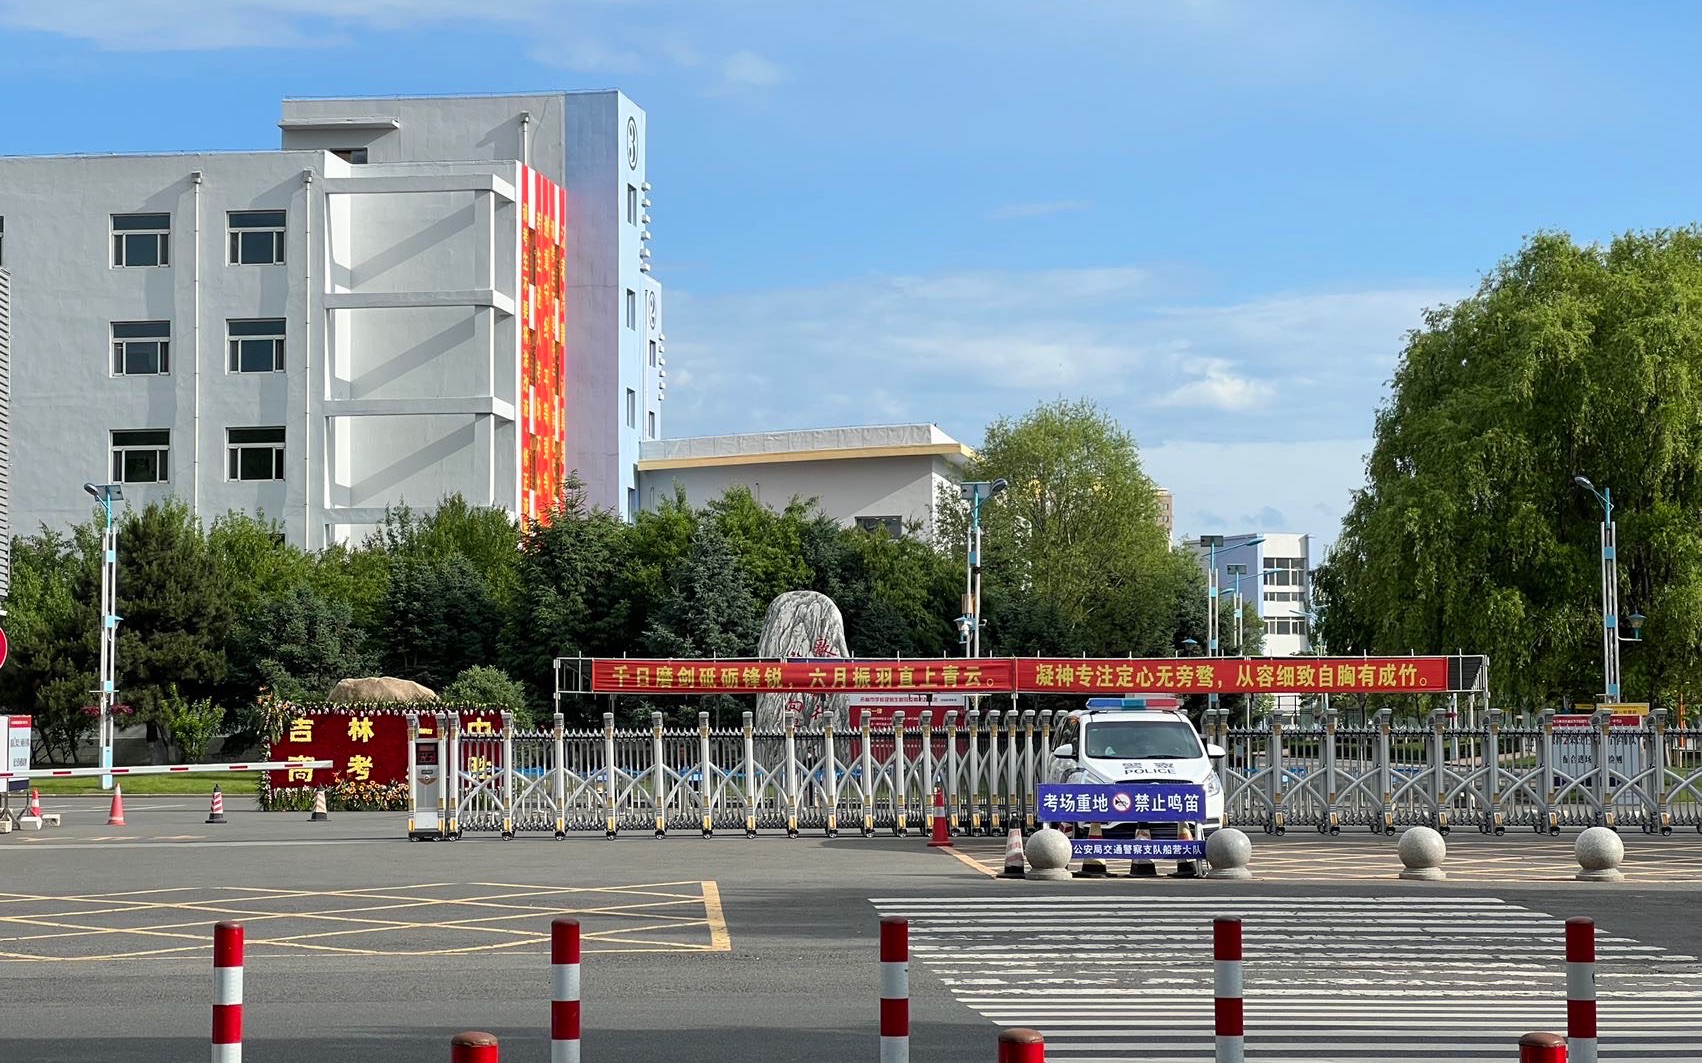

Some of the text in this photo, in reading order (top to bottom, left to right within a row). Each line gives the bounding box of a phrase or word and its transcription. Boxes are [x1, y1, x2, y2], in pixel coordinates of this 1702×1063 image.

[1035, 663, 1430, 689] 凝神专注定心无旁骛，从容细致自胸有成竹。
[1043, 793, 1200, 813] 考场重地 禁止鸣笛
